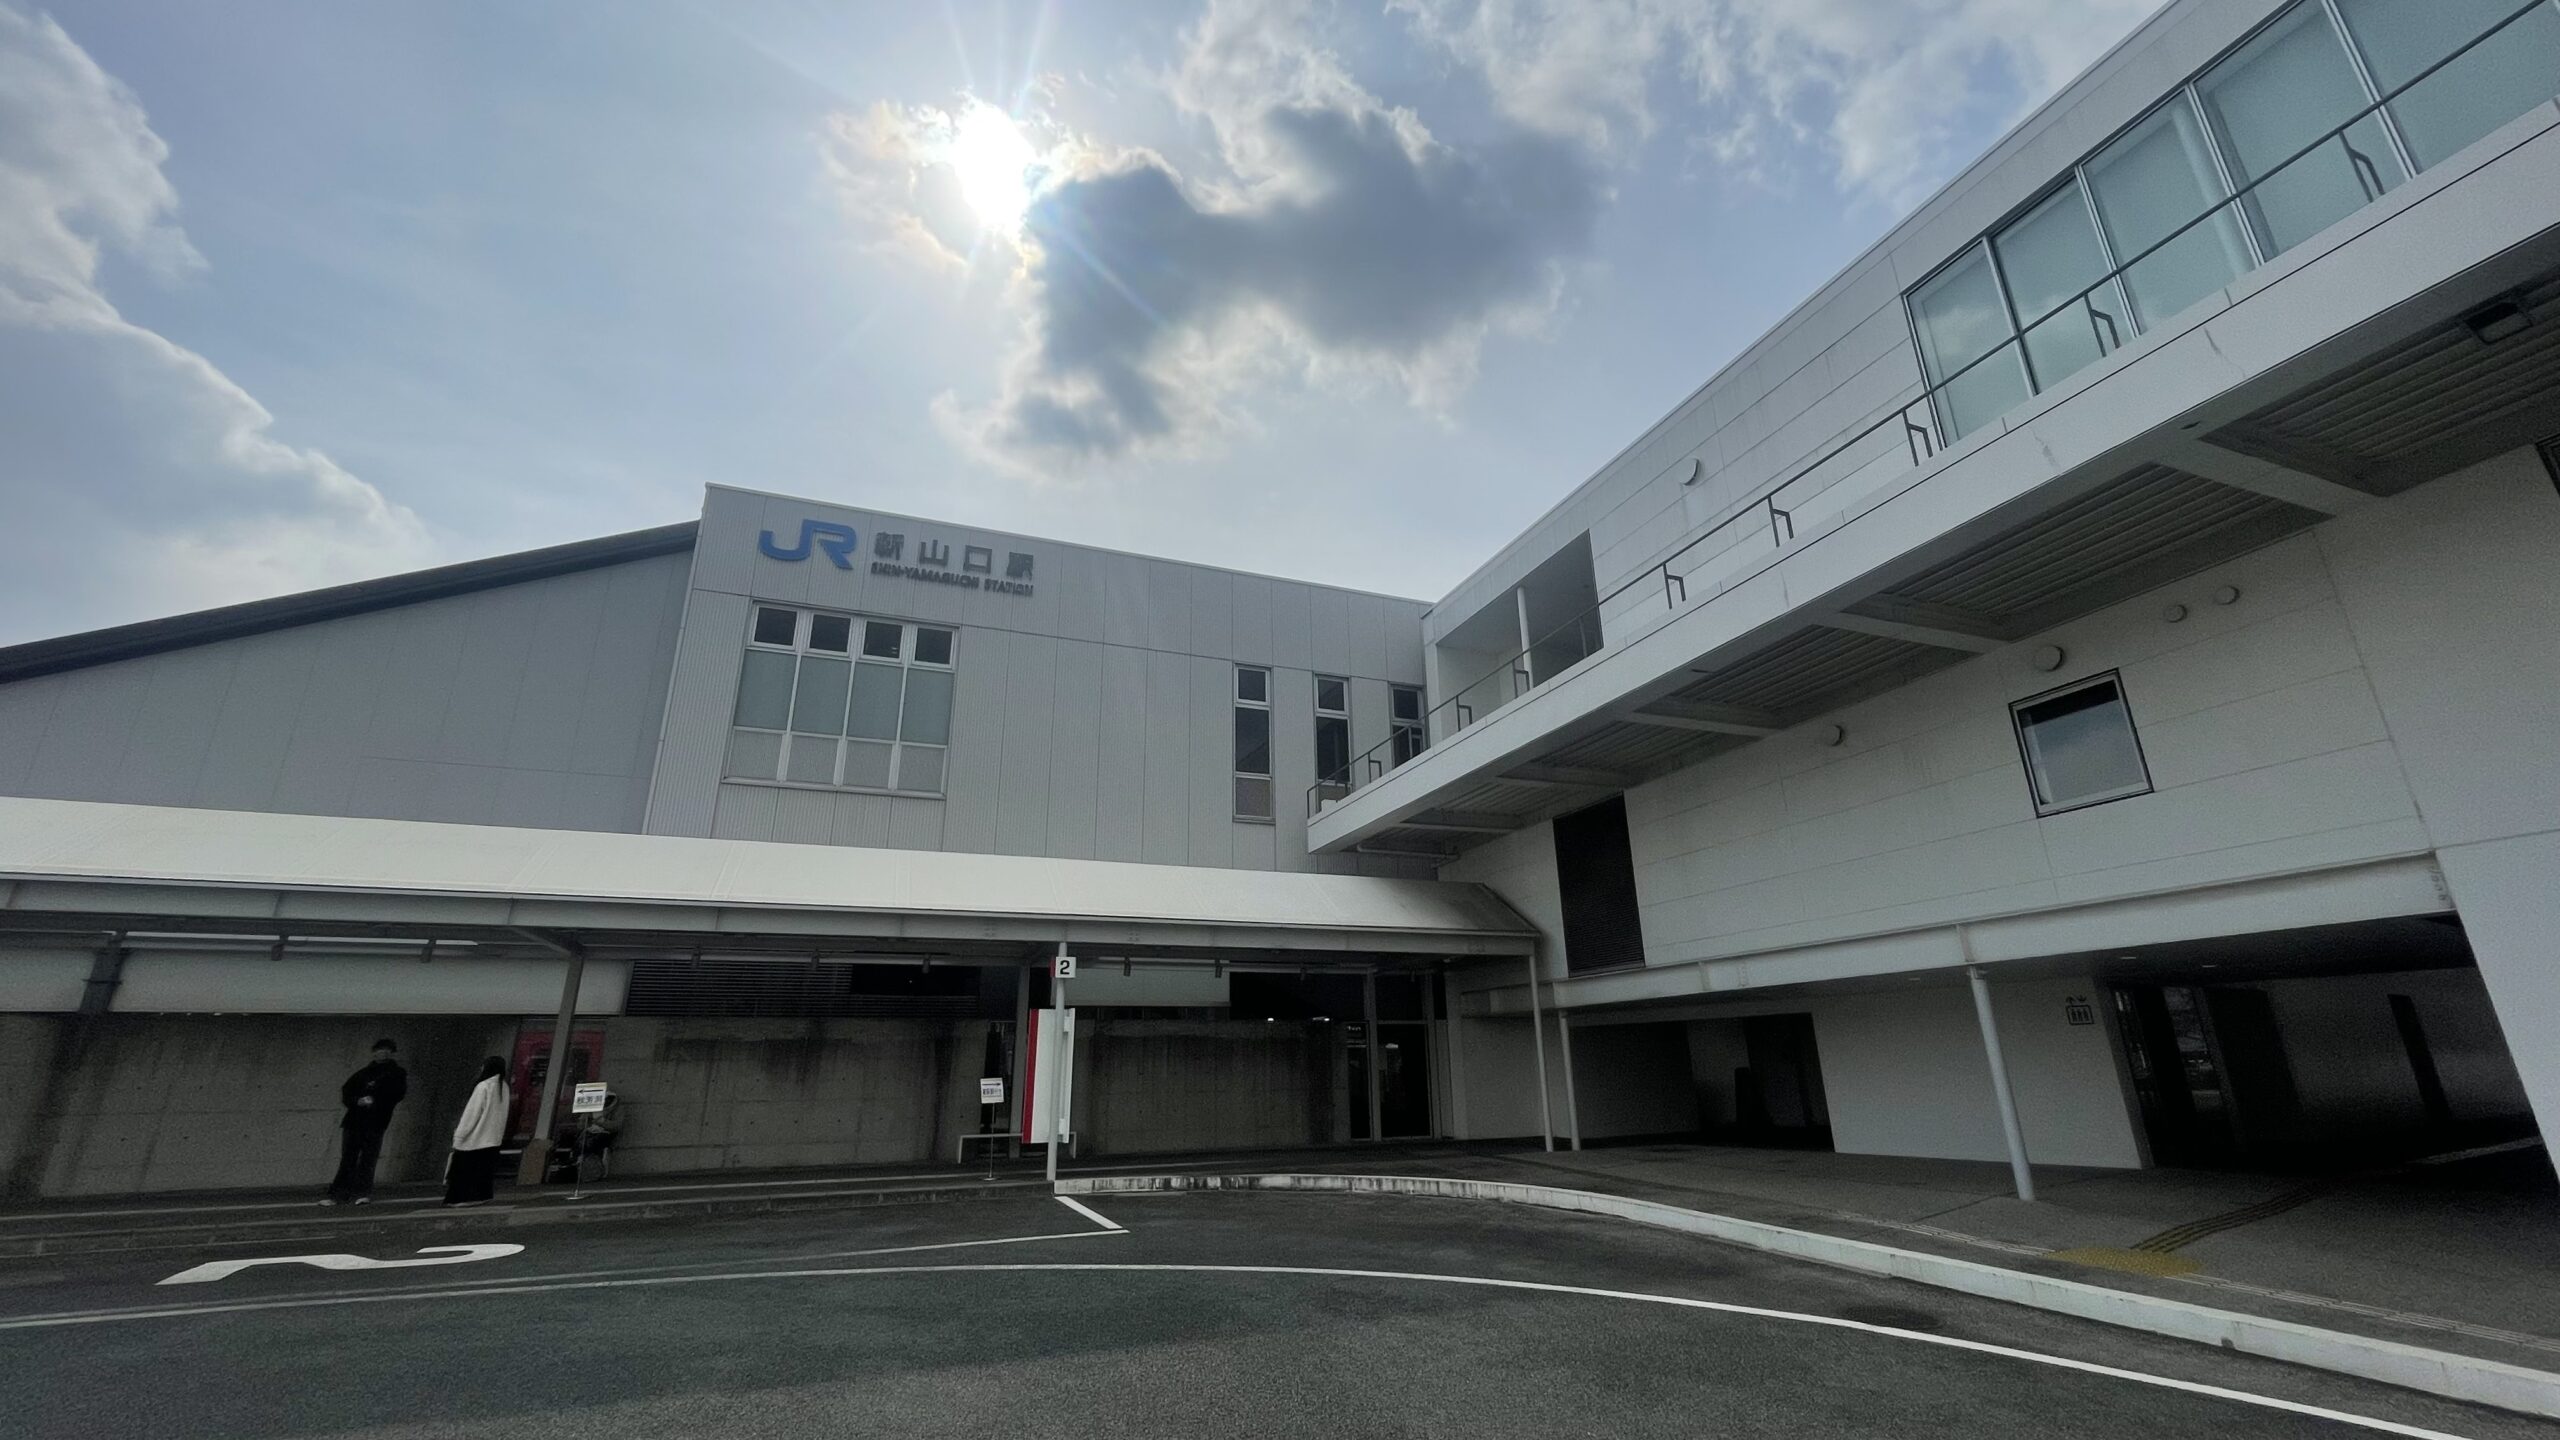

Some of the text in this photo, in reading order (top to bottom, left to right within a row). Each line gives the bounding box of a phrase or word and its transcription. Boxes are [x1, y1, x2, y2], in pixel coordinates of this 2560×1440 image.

[758, 519, 857, 571] JR
[984, 578, 1034, 597] STATION
[1060, 960, 1070, 975] 2
